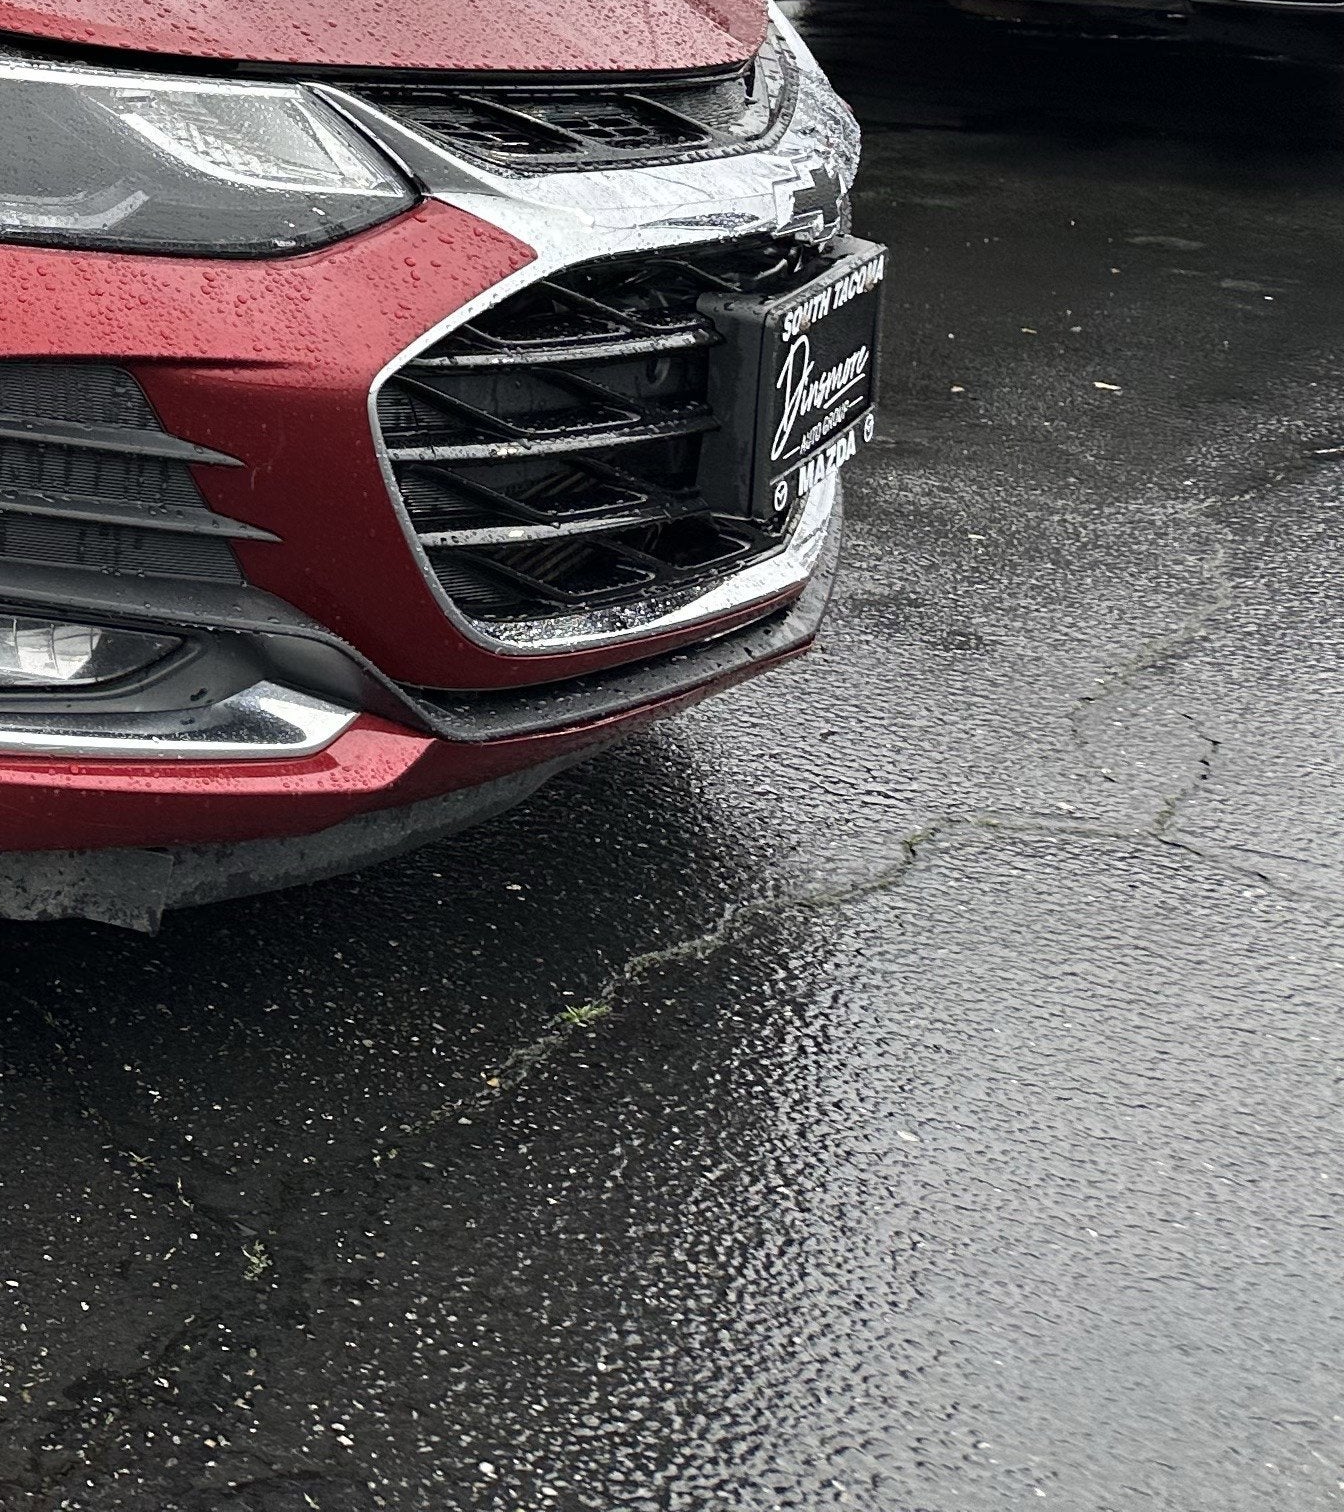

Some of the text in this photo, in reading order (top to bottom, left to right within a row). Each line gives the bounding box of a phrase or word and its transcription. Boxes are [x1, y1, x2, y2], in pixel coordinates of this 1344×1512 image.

[782, 254, 884, 342] SOUTH TACOMA
[770, 334, 869, 461] Dinsmore
[798, 429, 857, 496] MAZDA
